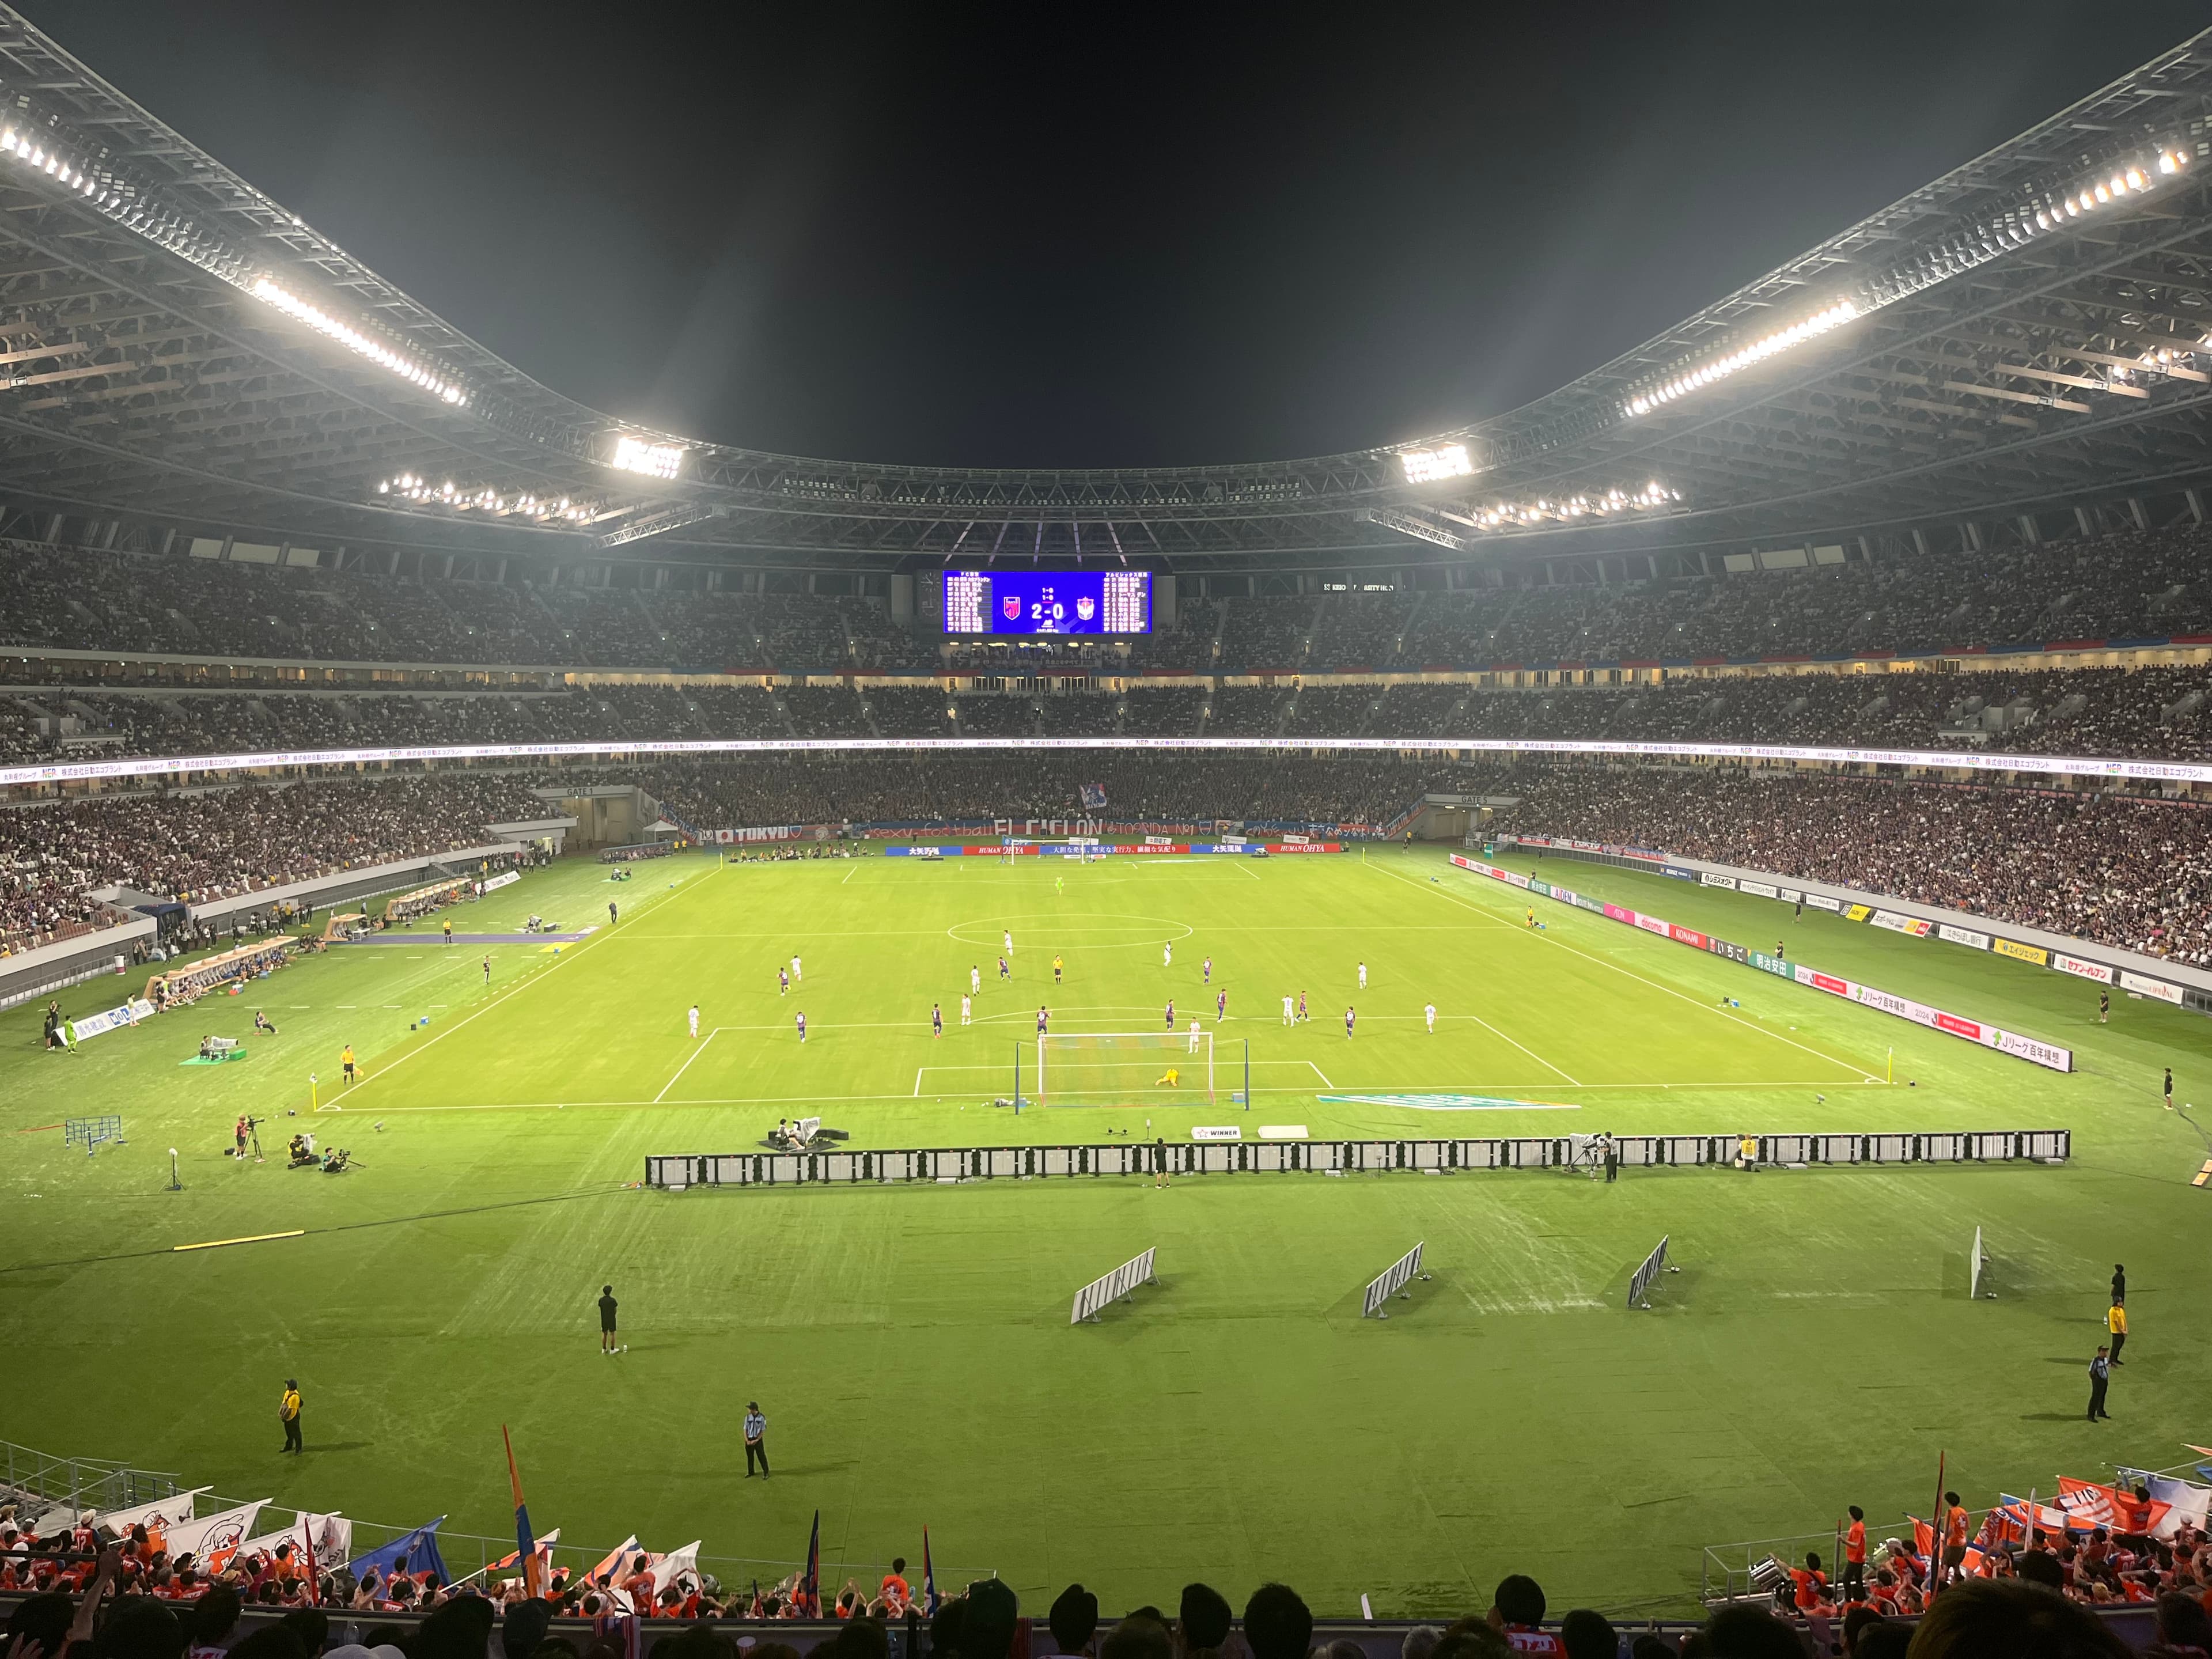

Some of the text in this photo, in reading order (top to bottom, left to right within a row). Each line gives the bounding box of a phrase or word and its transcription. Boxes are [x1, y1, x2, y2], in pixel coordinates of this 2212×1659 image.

[1031, 603, 1063, 619] 2-0
[735, 826, 789, 842] TOKYO
[1302, 844, 1325, 853] OHYA
[1641, 918, 1662, 933] docomo
[1675, 929, 1698, 944] KONAMI
[1717, 941, 1744, 961] いちご
[2009, 945, 2040, 960] エイジェック
[1756, 953, 1786, 976] 明治安田
[1797, 970, 1808, 980] 2024
[2149, 985, 2174, 999] LIFEVAL
[1863, 991, 1906, 1013] Jリーグ百年構想
[1915, 1009, 1929, 1020] 2024
[2002, 1037, 2059, 1064] Jリーグ百年構想
